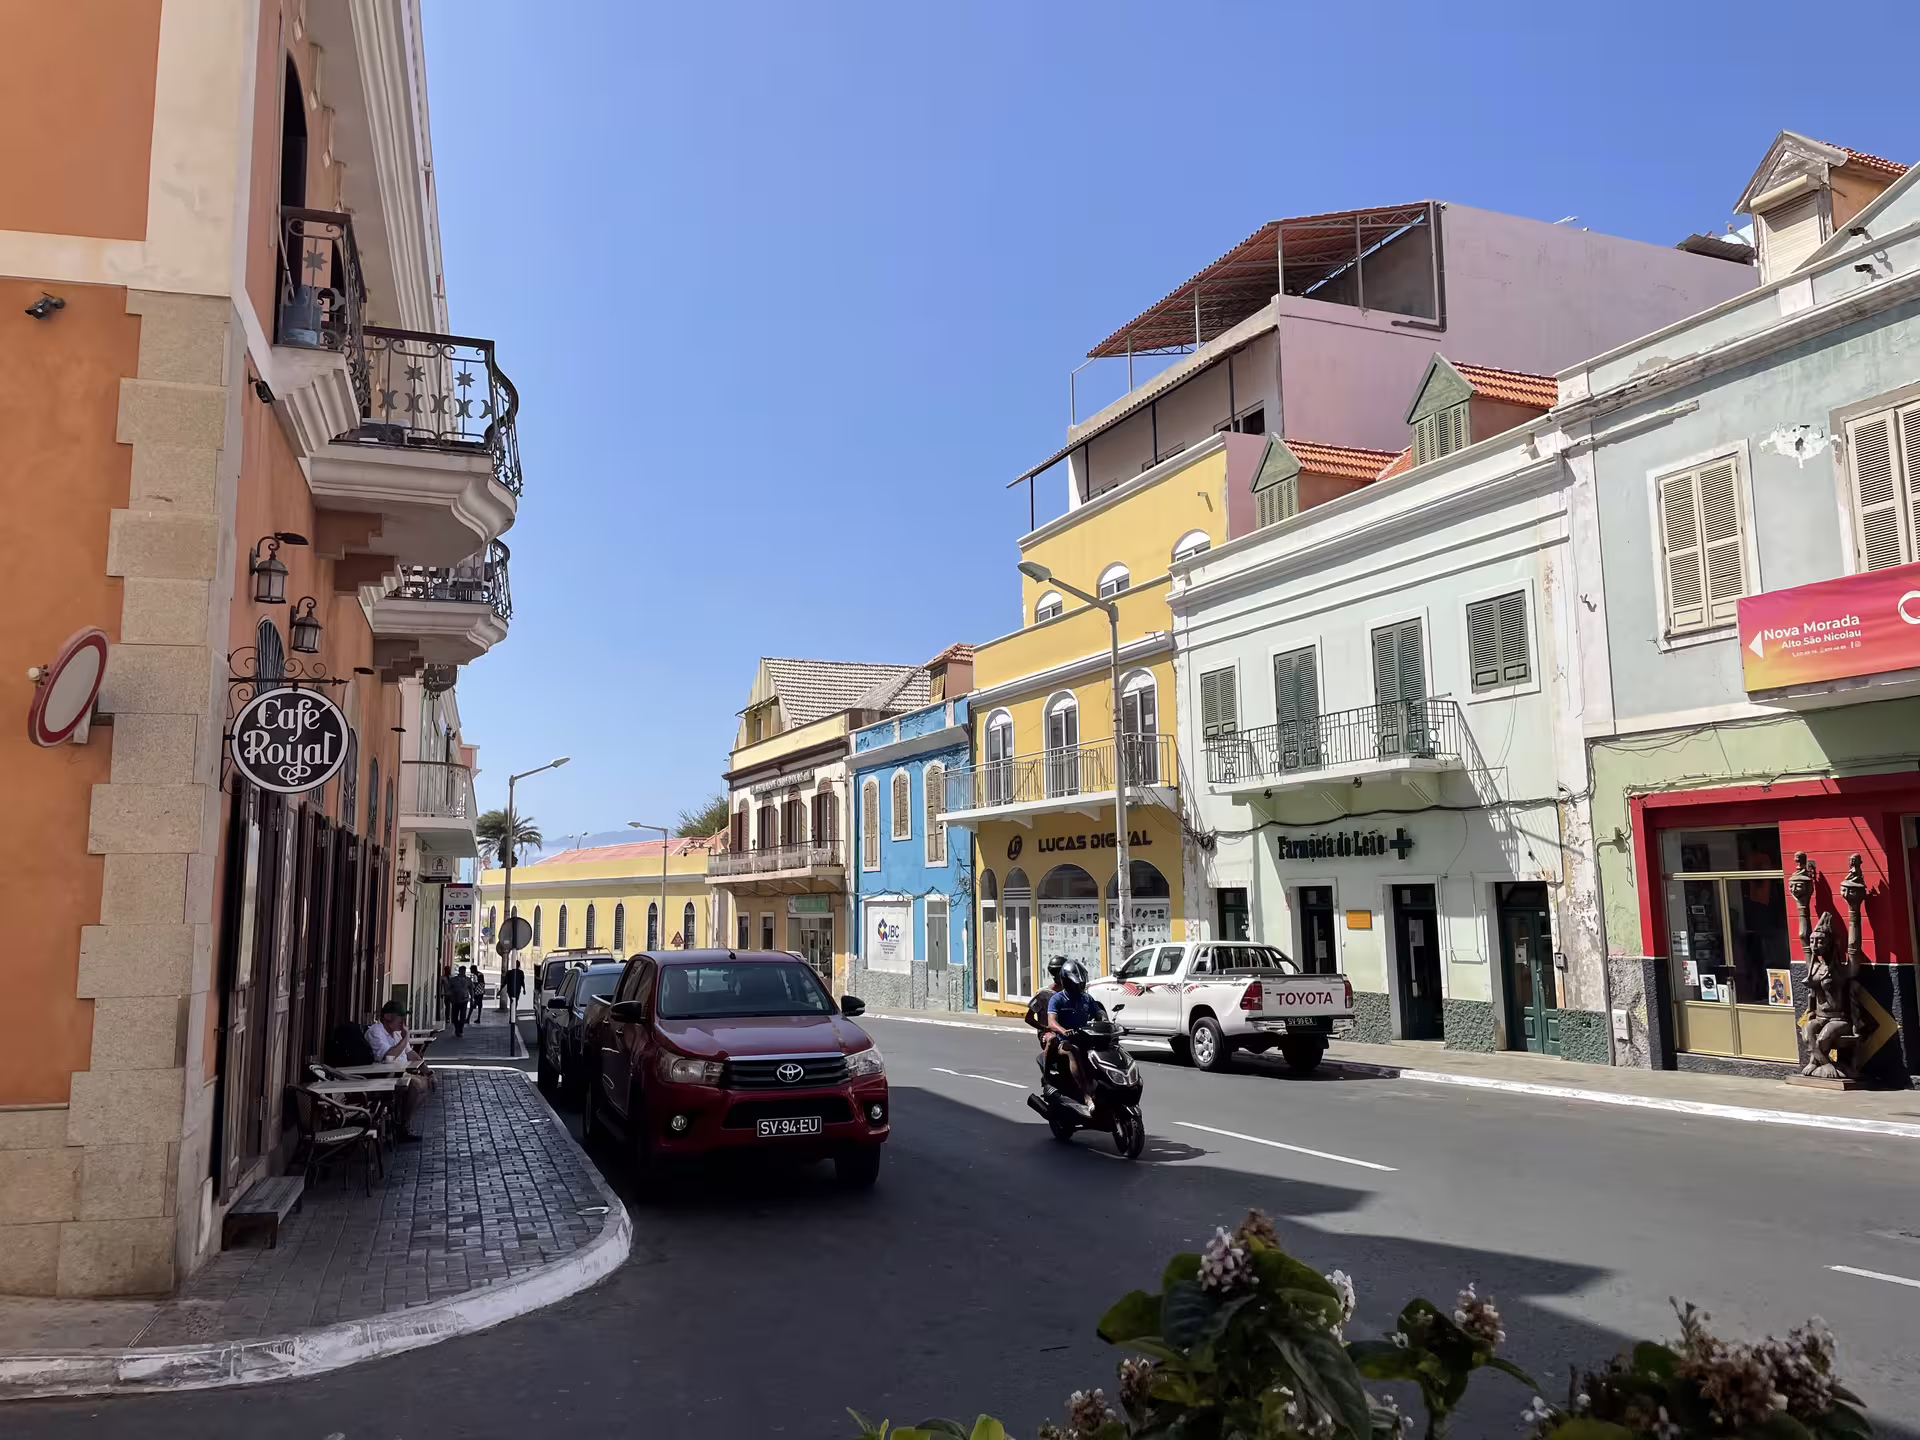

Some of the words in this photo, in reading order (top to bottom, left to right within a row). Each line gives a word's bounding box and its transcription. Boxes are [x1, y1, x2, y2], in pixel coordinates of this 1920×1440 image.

[1764, 626, 1800, 641] Nova
[1803, 614, 1861, 634] Morada
[1781, 638, 1802, 649] Alto
[1803, 633, 1822, 645] São
[1823, 629, 1862, 642] Nicolau
[256, 698, 332, 742] Café
[243, 730, 337, 785] Royal
[1038, 835, 1087, 853] LUCAS
[1337, 831, 1352, 857] do
[1353, 829, 1386, 856] Leão
[1276, 992, 1333, 1006] TOYOTA
